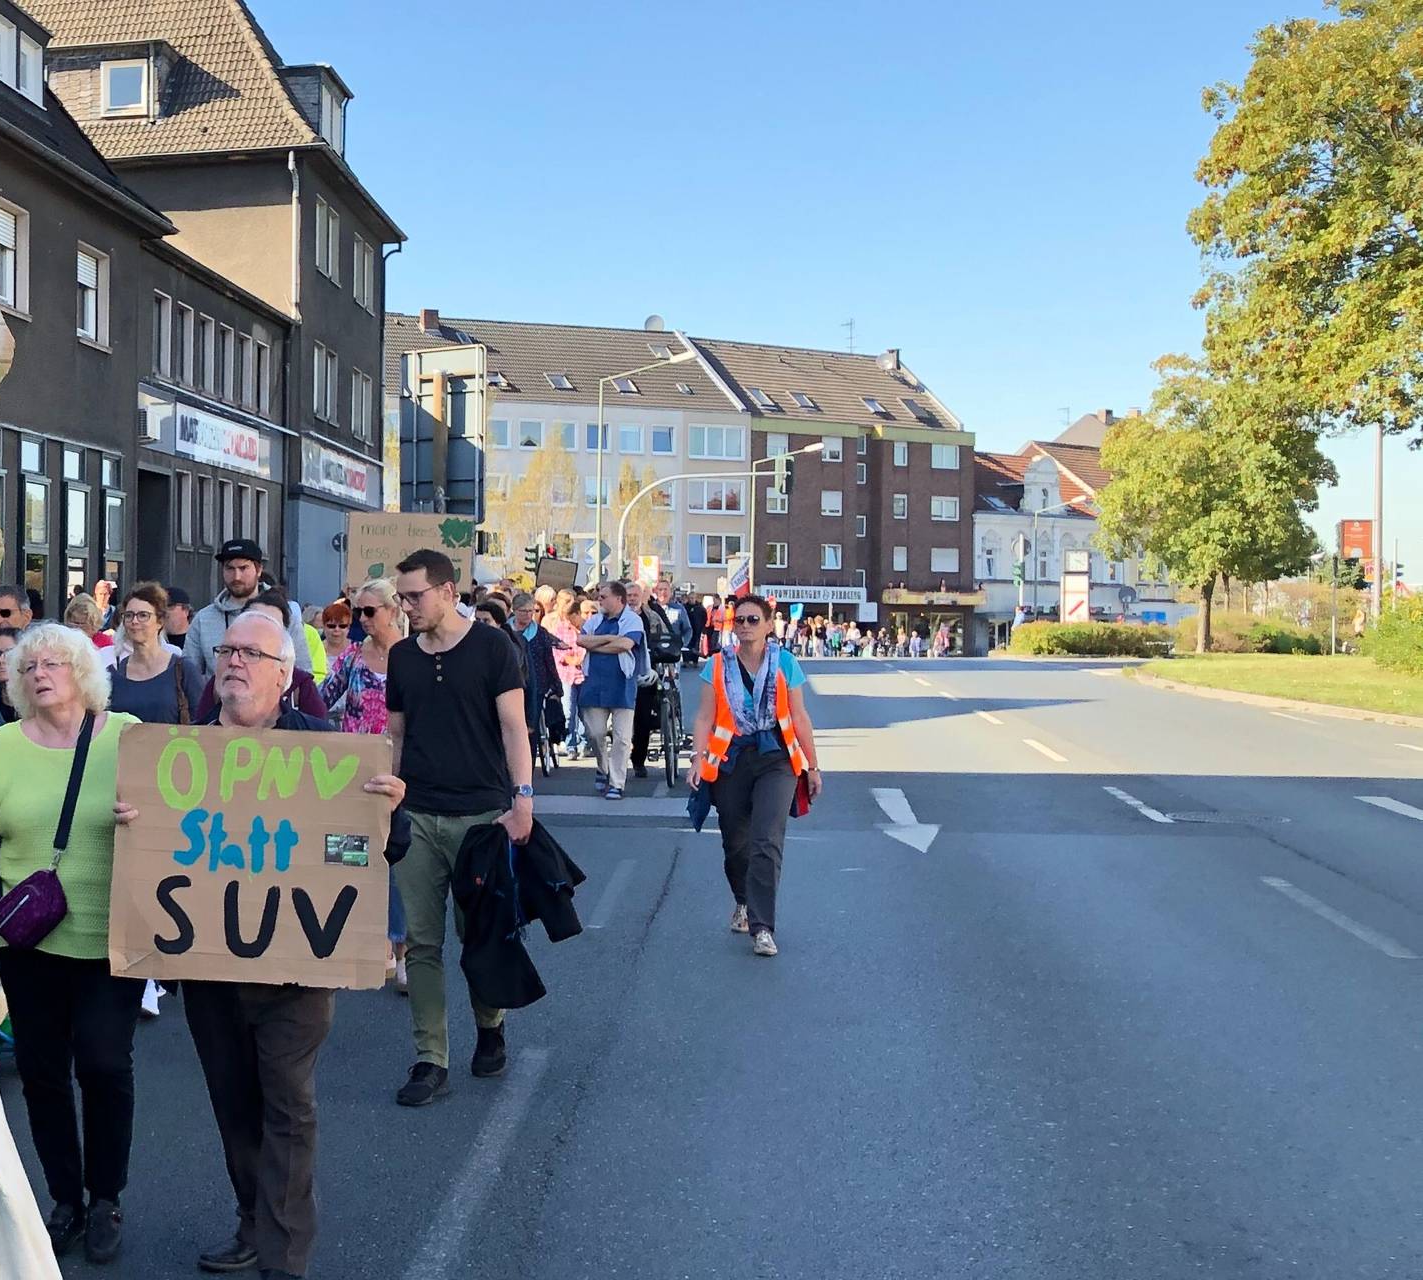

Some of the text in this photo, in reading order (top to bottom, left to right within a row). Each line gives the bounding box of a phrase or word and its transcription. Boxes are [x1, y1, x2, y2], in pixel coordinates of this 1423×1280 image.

[156, 726, 360, 811] ÖPNV
[172, 808, 299, 874] Statt
[153, 874, 358, 959] SUV
